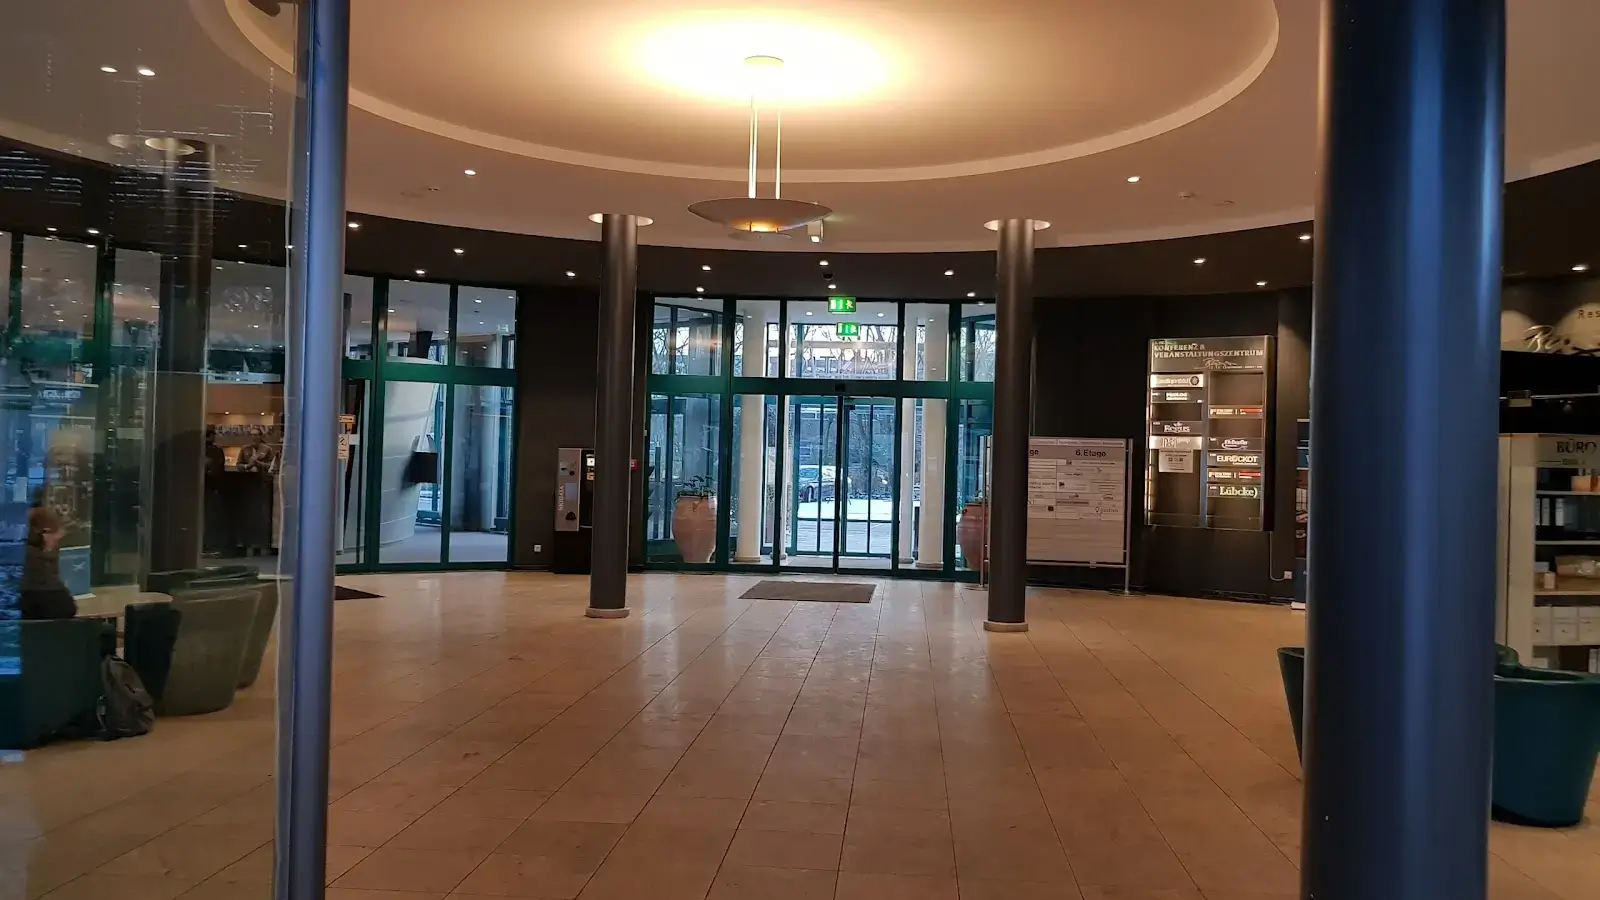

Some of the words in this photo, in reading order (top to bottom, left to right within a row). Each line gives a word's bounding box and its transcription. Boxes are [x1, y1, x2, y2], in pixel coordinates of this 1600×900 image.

[1154, 343, 1198, 352] KONFERENZ
[1154, 350, 1264, 359] VERANSTALTUNGSZENTRUM
[1164, 425, 1191, 433] Regus
[1557, 438, 1597, 453] BÜRO
[1083, 449, 1107, 457] Etage
[1216, 455, 1258, 463] EUROCKOT
